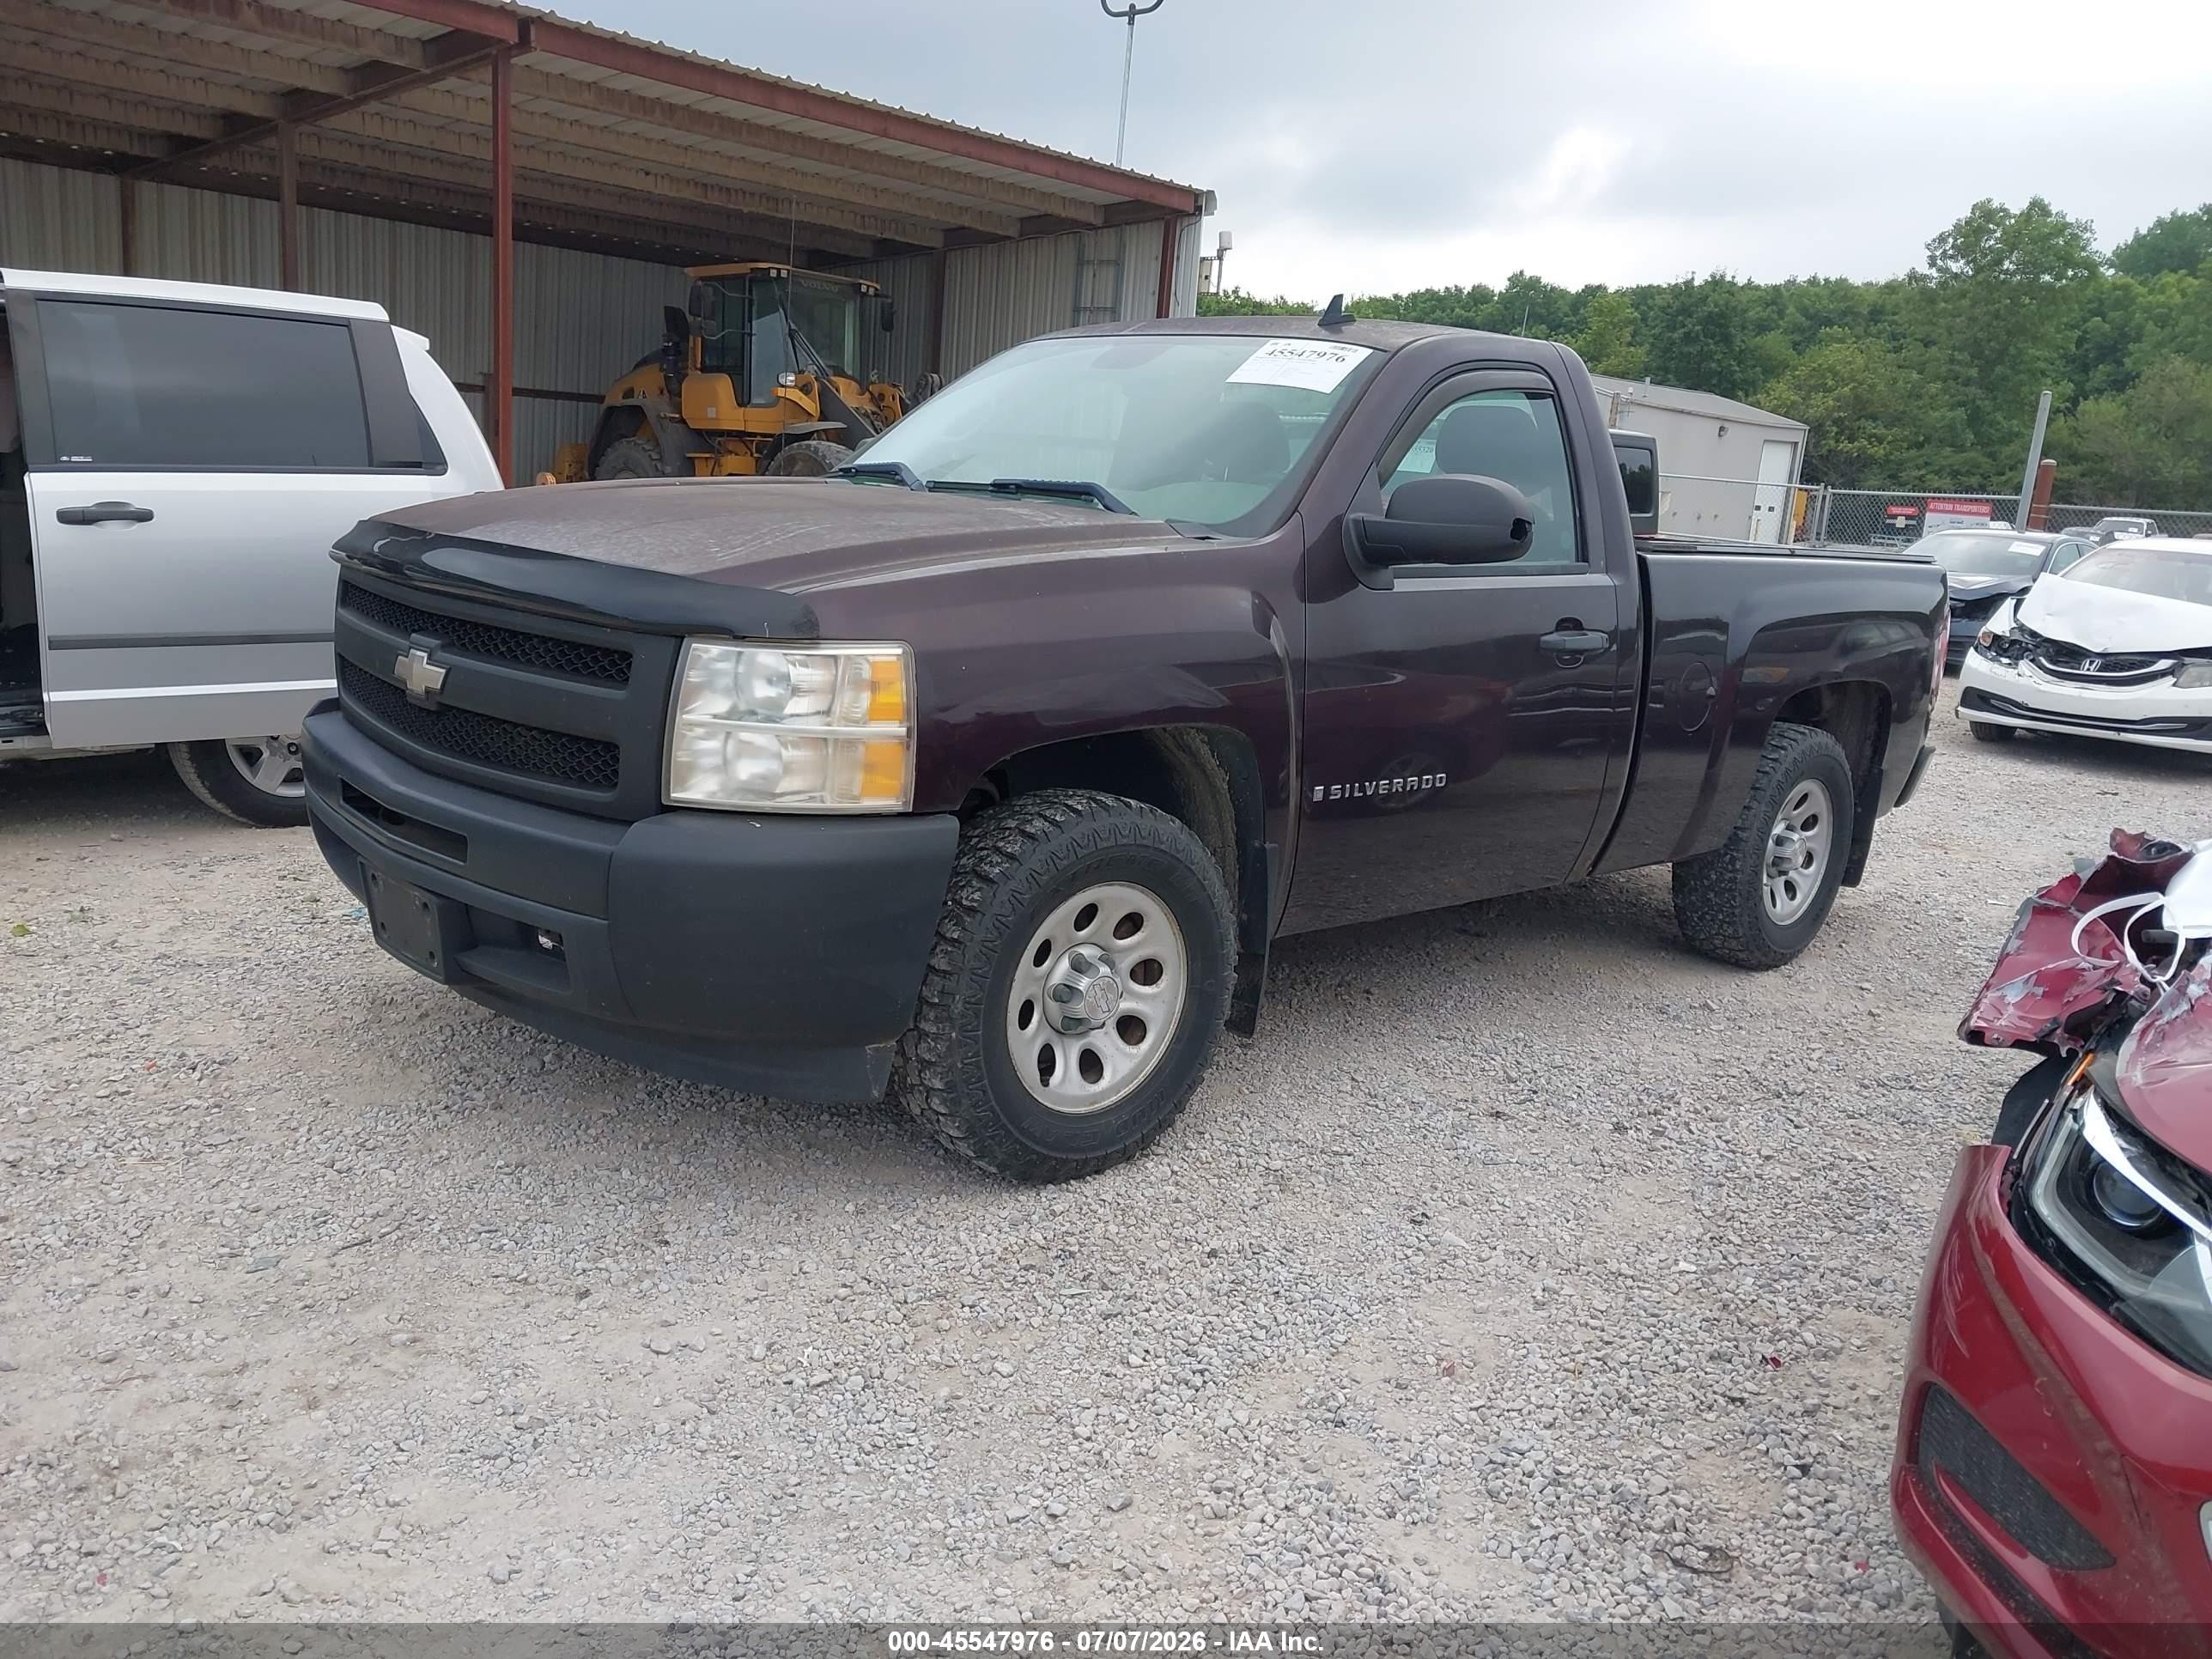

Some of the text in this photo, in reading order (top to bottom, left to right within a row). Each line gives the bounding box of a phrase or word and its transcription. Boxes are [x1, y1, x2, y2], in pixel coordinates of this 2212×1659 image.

[1265, 348, 1346, 363] 45547976
[1929, 502, 1953, 511] ATTENTION
[1329, 773, 1447, 800] SILVERADO
